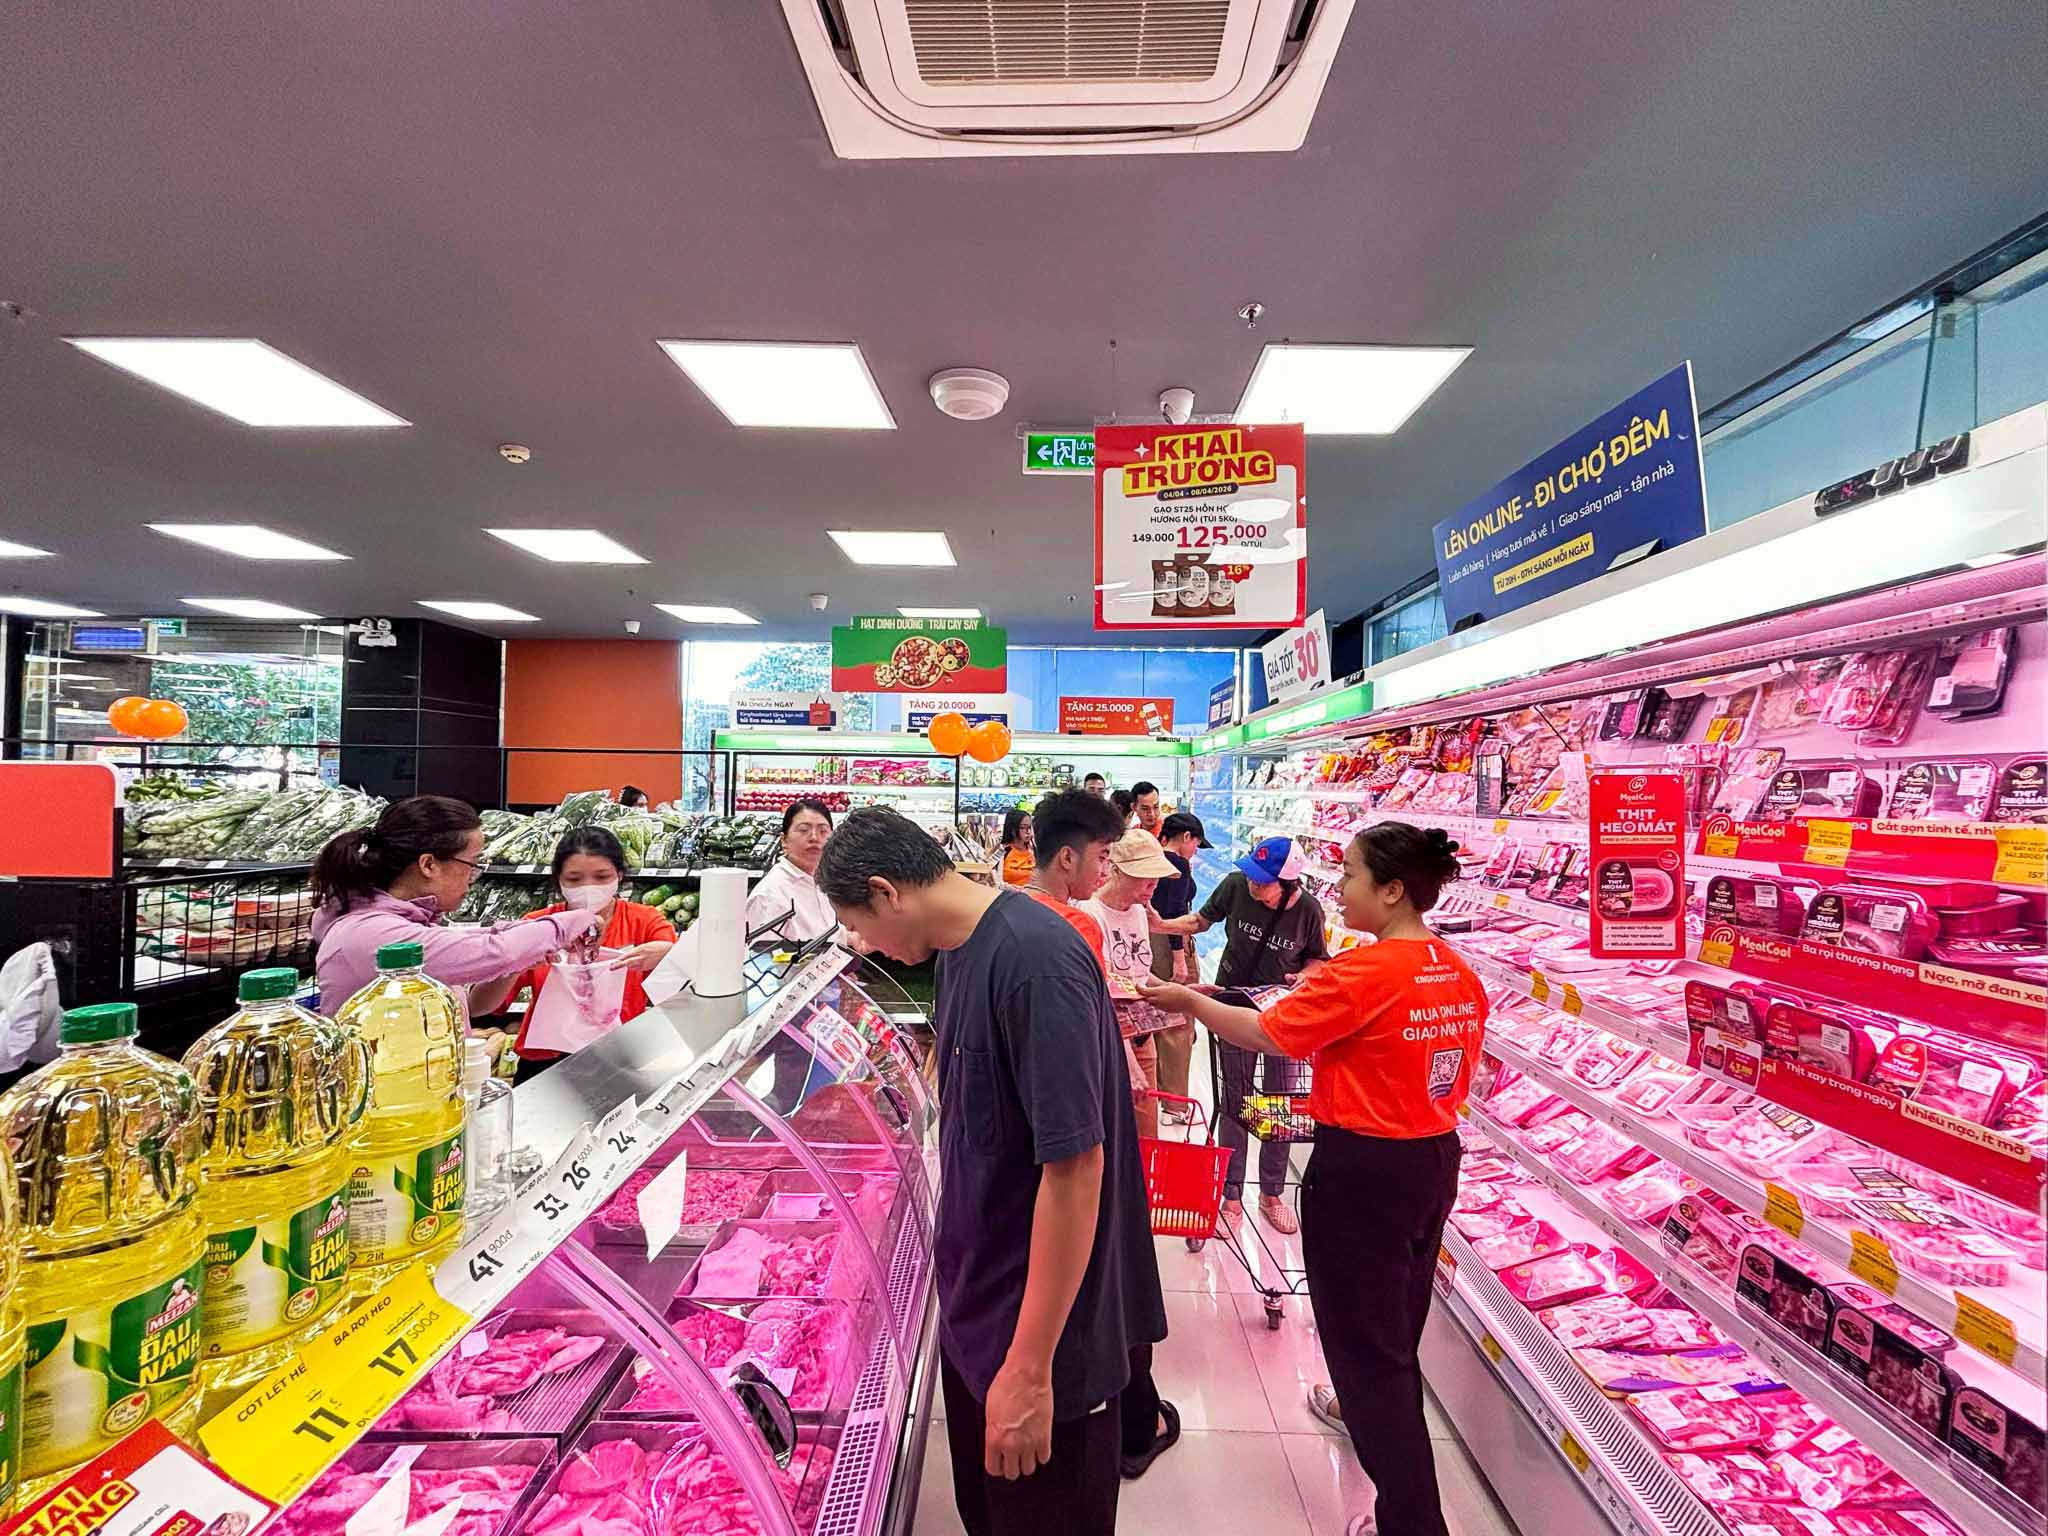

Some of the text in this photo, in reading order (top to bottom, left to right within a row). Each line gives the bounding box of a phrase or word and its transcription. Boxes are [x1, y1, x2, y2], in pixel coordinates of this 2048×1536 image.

[1079, 456, 1095, 465] EX
[1158, 433, 1239, 461] KHAI
[1125, 455, 1271, 489] TRƯƠNG
[1444, 528, 1468, 560] LÊN
[1469, 495, 1523, 545] ONLINE
[1534, 478, 1556, 509] ĐI
[1558, 441, 1607, 494] CHỢ
[1609, 408, 1669, 467] ĐÊM
[1163, 490, 1184, 499] 04/04
[1191, 485, 1232, 497] 08/04/2026
[1559, 512, 1578, 527] Giao
[1579, 498, 1602, 518] sáng
[1604, 485, 1622, 506] mai
[1631, 472, 1650, 494] tận
[1651, 459, 1675, 483] nhà
[1150, 515, 1181, 524] HƯƠNG
[1174, 505, 1194, 513] ST25
[1132, 533, 1175, 543] 149.000
[1533, 557, 1553, 574] SÁNG
[1568, 540, 1590, 558] NGÀY
[1267, 652, 1279, 680] GIÁ
[1279, 645, 1294, 672] TỐT
[938, 701, 976, 709] 20.000Đ
[1067, 700, 1135, 713] TẶNG 25.000Đ
[1617, 808, 1656, 821] THỊT
[1900, 825, 1925, 834] gọn
[1926, 823, 1952, 833] tinh
[1734, 822, 1786, 839] MeatCool
[1238, 919, 1297, 950] VERSLLES
[1739, 935, 1792, 958] MeatCool
[1802, 943, 1916, 978] Ba rọi thượng hạng
[1923, 969, 2046, 1001] Nạc, mỡ đan xe
[1409, 1002, 1477, 1023] MUA ONLINE
[1402, 1026, 1438, 1041] GIAO
[1467, 1019, 1479, 1033] 2H
[1784, 1061, 1806, 1077] Thịt
[1807, 1071, 1827, 1085] xay
[1828, 1076, 1863, 1099] trong
[1863, 1089, 1897, 1110] ngày
[607, 1130, 638, 1155] 24
[1904, 1103, 1945, 1126] Nhiều
[1982, 1131, 1995, 1145] ít
[1997, 1138, 2025, 1155] mỡ
[562, 1160, 592, 1192] 26
[533, 1192, 569, 1220] 33
[468, 1228, 514, 1283] 41 900đ
[333, 1330, 351, 1347] BA
[350, 1315, 371, 1333] RỌI
[370, 1296, 392, 1316] HEO
[368, 1337, 419, 1377] 17
[406, 1310, 441, 1340] 500đ
[289, 1362, 307, 1381] HE
[293, 1406, 350, 1443] 11
[16, 1491, 84, 1536] HAI
[53, 1483, 131, 1536] ƠNG
